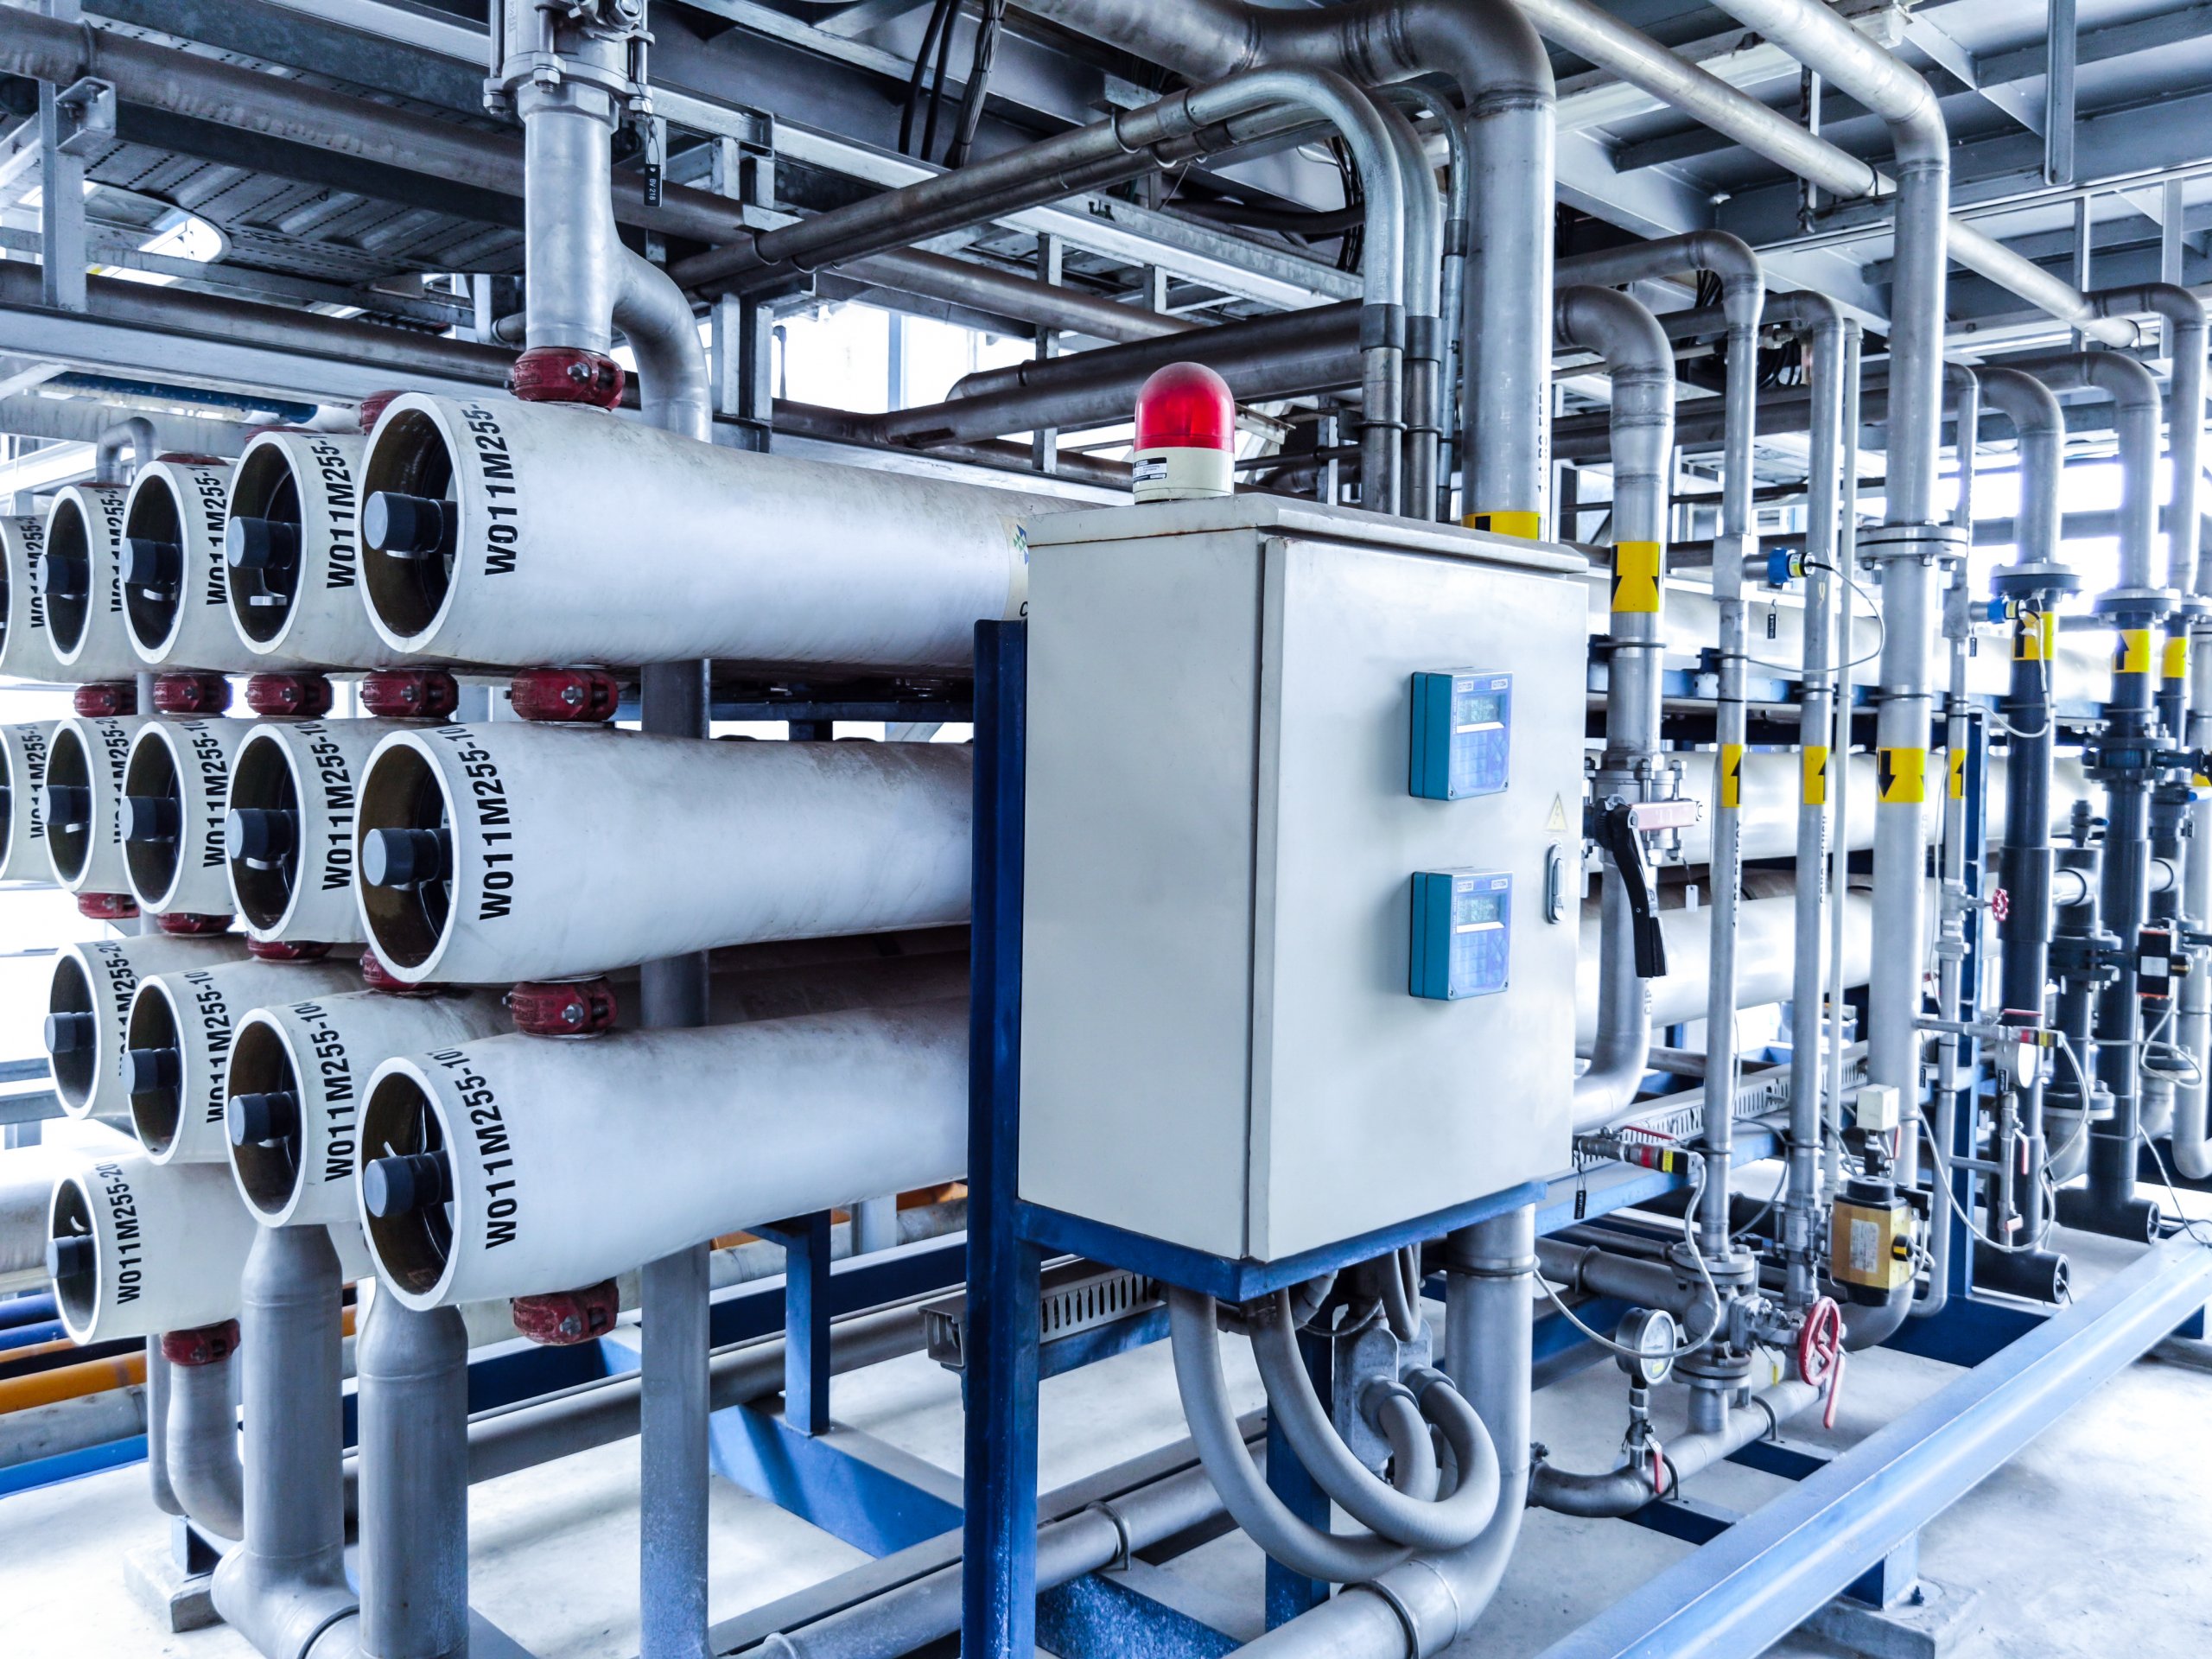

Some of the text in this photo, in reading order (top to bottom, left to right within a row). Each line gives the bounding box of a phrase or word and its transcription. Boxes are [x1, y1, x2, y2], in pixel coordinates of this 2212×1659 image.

[456, 398, 518, 576] W011M255-
[181, 969, 232, 1123] W011M255-10
[95, 1160, 143, 1306] W011M255-20
